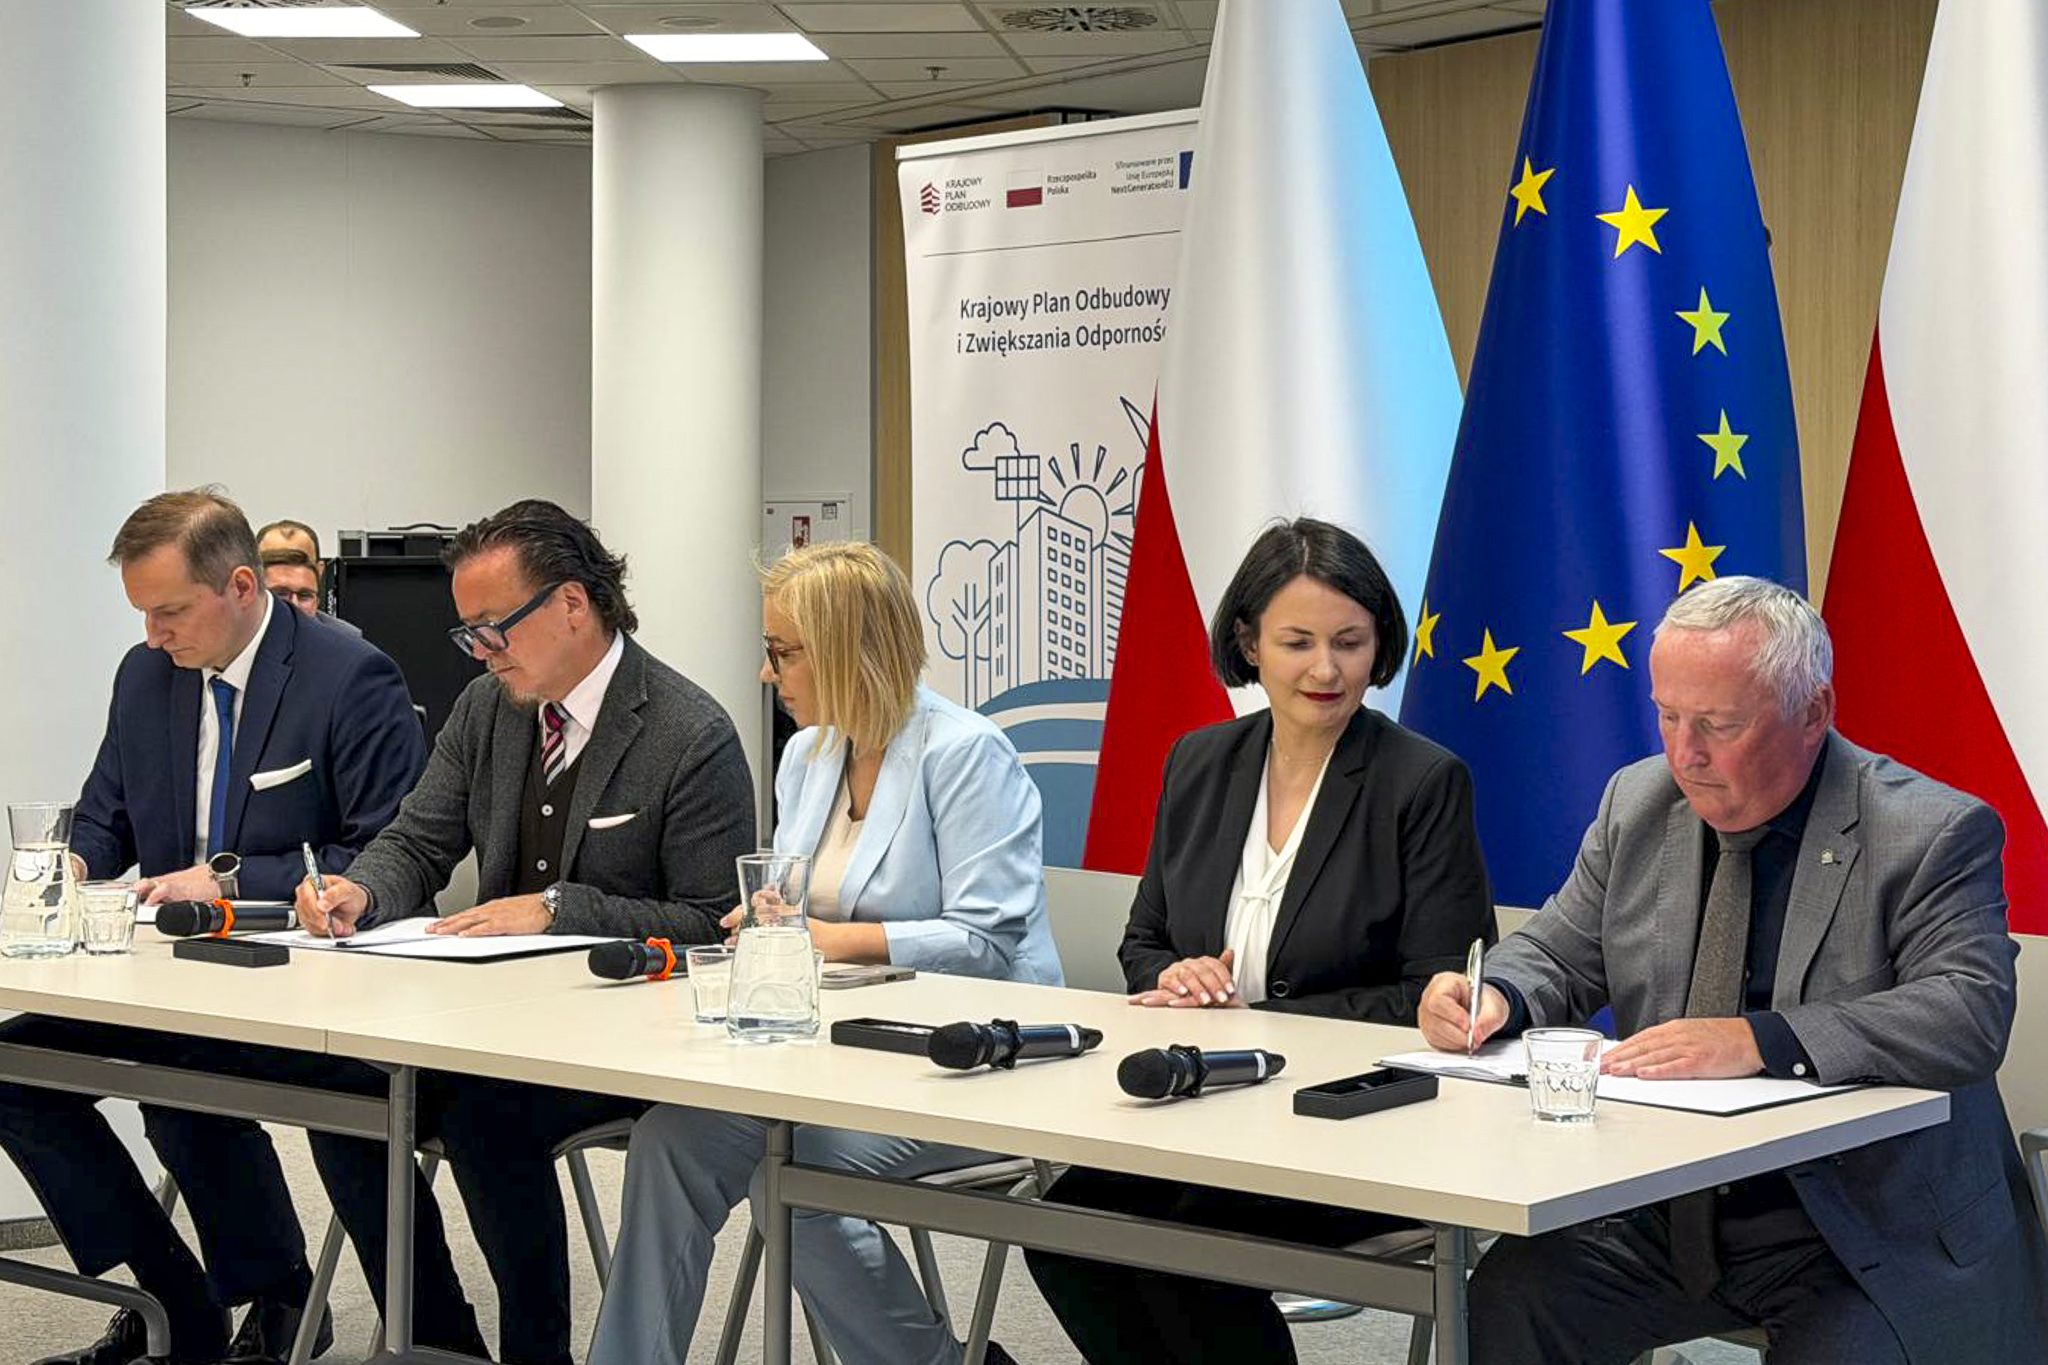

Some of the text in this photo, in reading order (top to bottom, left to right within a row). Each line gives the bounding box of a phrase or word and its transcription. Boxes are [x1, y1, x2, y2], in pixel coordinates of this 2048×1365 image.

[945, 177, 982, 188] KRAJOWY
[945, 190, 966, 200] PLAN
[960, 284, 1171, 323] Krajowy Plan Odbudowy
[957, 332, 963, 354] i
[965, 326, 1070, 357] Zwiększania
